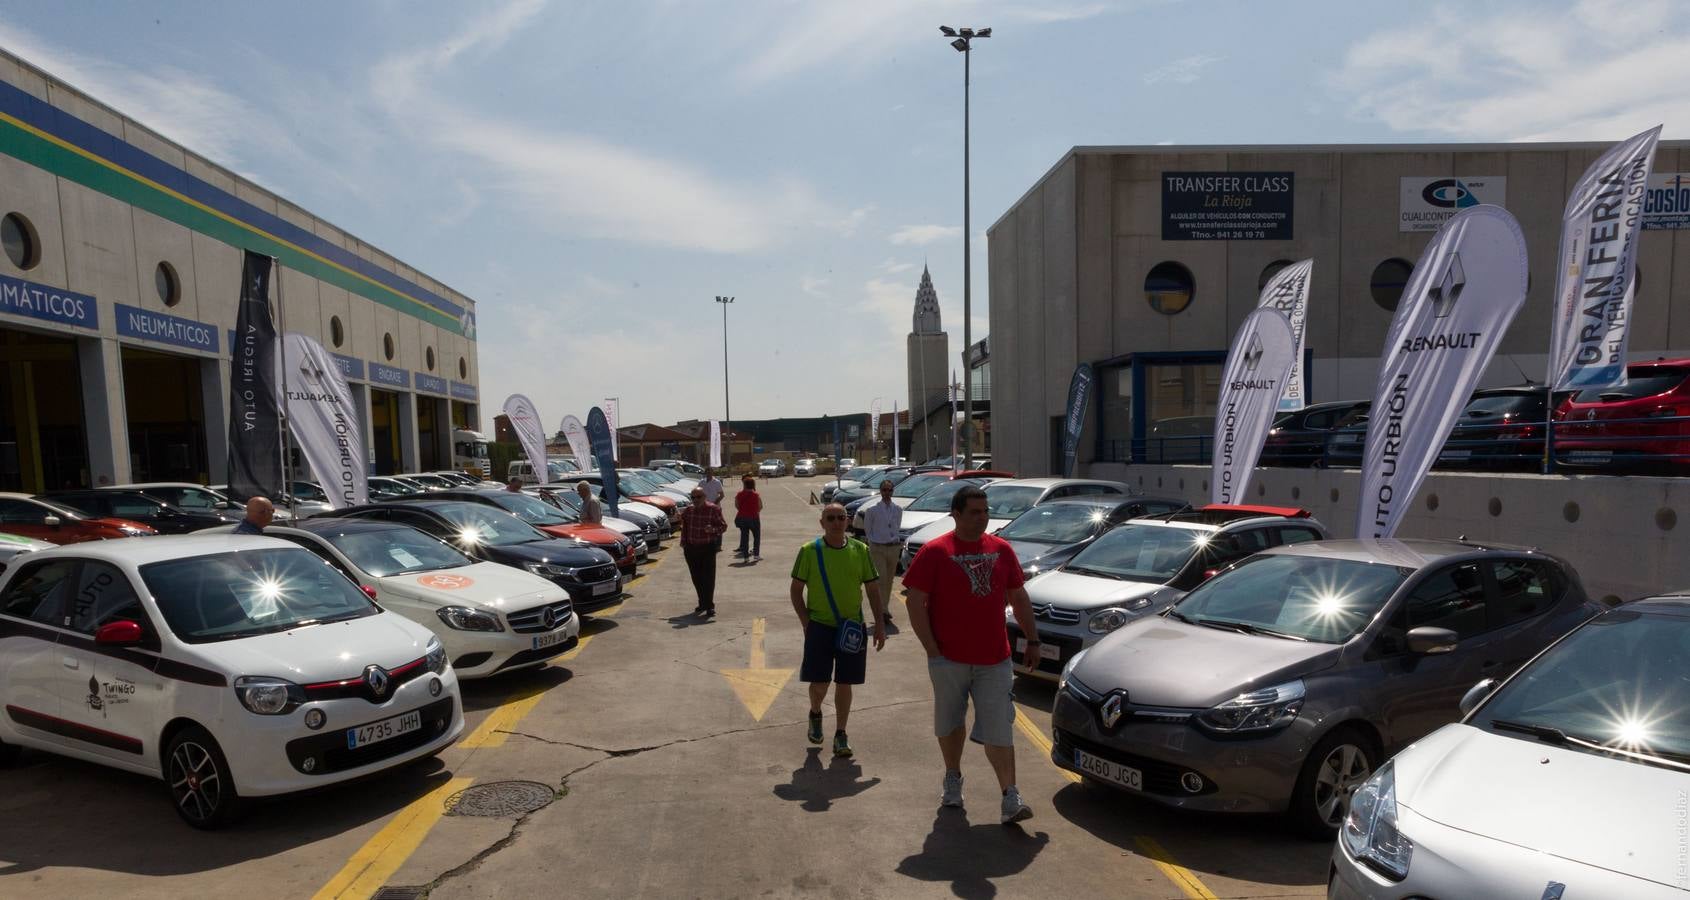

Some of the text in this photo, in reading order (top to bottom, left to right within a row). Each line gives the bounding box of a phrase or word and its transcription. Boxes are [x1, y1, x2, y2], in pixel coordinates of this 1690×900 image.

[1167, 177, 1289, 192] TRANSFER CLASS
[1204, 195, 1252, 209] La Rioja
[1576, 164, 1626, 366] GRAN FERIA
[0, 282, 85, 320] MÁTICOS
[129, 313, 210, 345] NEUMÁTICOS
[1401, 333, 1481, 353] RENAULT
[1608, 334, 1624, 363] DEL
[1231, 380, 1275, 390] RENAULT
[1289, 381, 1299, 398] DEL
[1382, 373, 1408, 477] URBIÓN
[1222, 403, 1235, 504] UTO URBIÓN
[103, 682, 136, 695] TWINGO
[358, 713, 419, 744] 4735 JHH
[1082, 754, 1138, 786] 2460 JGC
